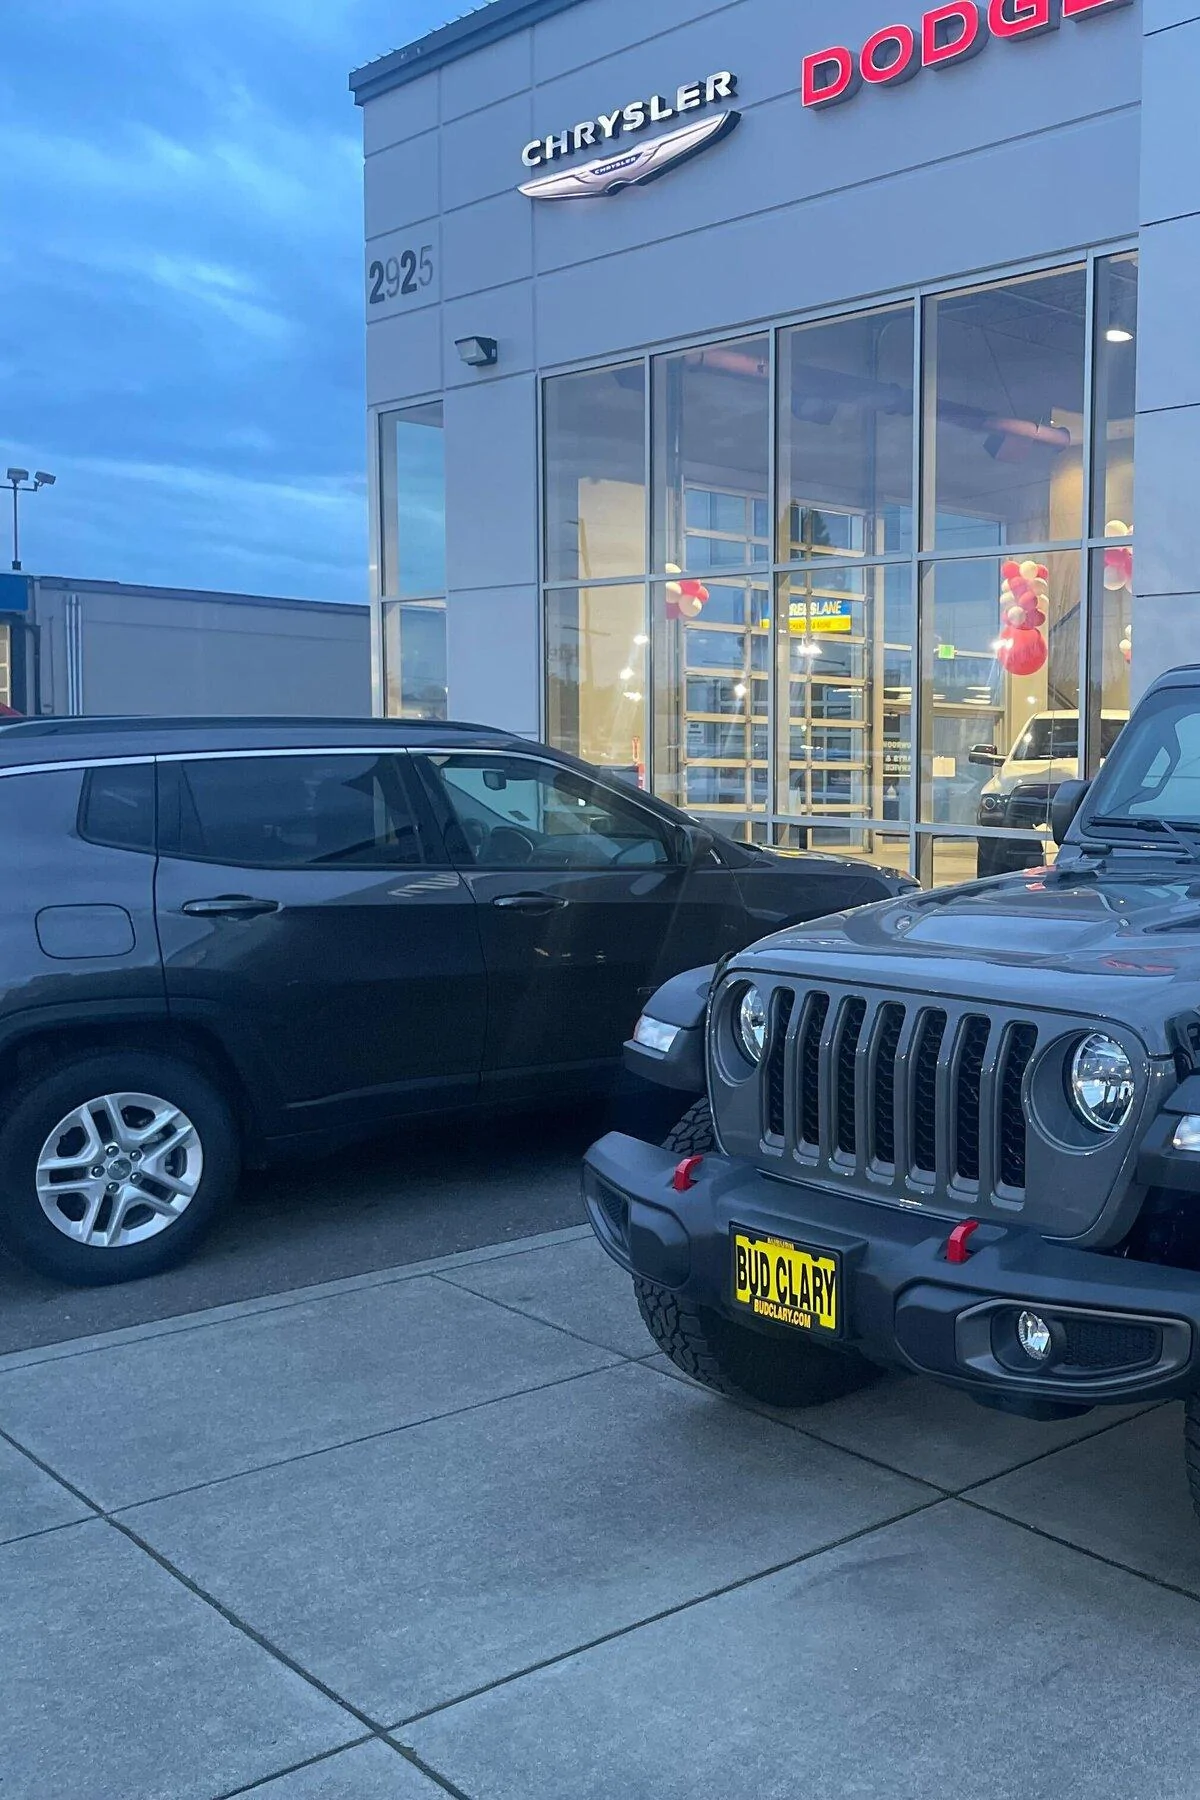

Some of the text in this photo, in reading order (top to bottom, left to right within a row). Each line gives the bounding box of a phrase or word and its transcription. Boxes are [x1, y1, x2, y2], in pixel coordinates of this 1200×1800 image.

[802, 0, 1128, 107] DODG
[521, 71, 733, 167] CHRYSLER
[594, 156, 637, 175] CHRYSLER
[369, 245, 433, 304] 2925
[737, 1244, 836, 1317] BUD CLARY
[754, 1299, 811, 1328] BUDCLARY.COM
